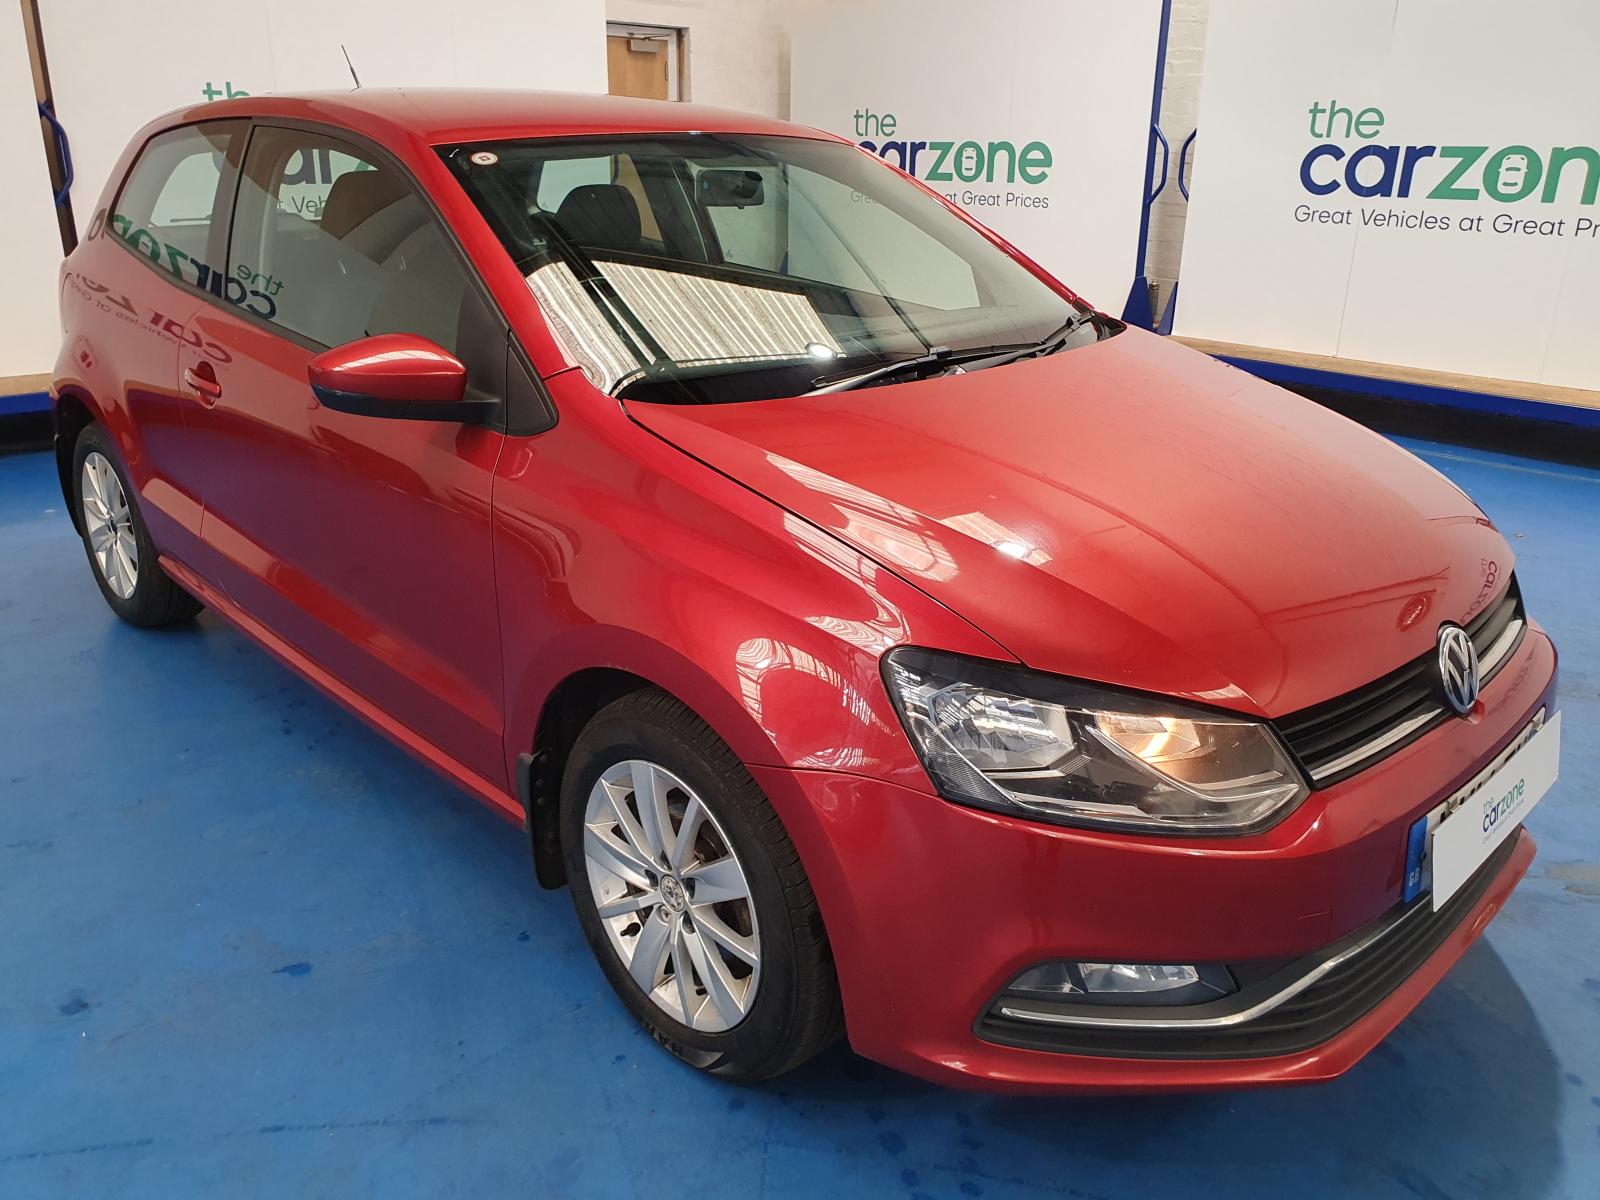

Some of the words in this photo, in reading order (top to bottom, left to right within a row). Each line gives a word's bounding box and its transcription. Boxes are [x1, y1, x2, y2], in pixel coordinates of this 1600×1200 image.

[853, 108, 897, 137] the
[1308, 100, 1385, 139] the
[962, 190, 1001, 207] Great
[1006, 192, 1049, 209] Prices
[1294, 204, 1352, 225] Great
[1361, 208, 1450, 230] Vehicles
[1458, 215, 1484, 232] at
[1492, 213, 1565, 237] Great
